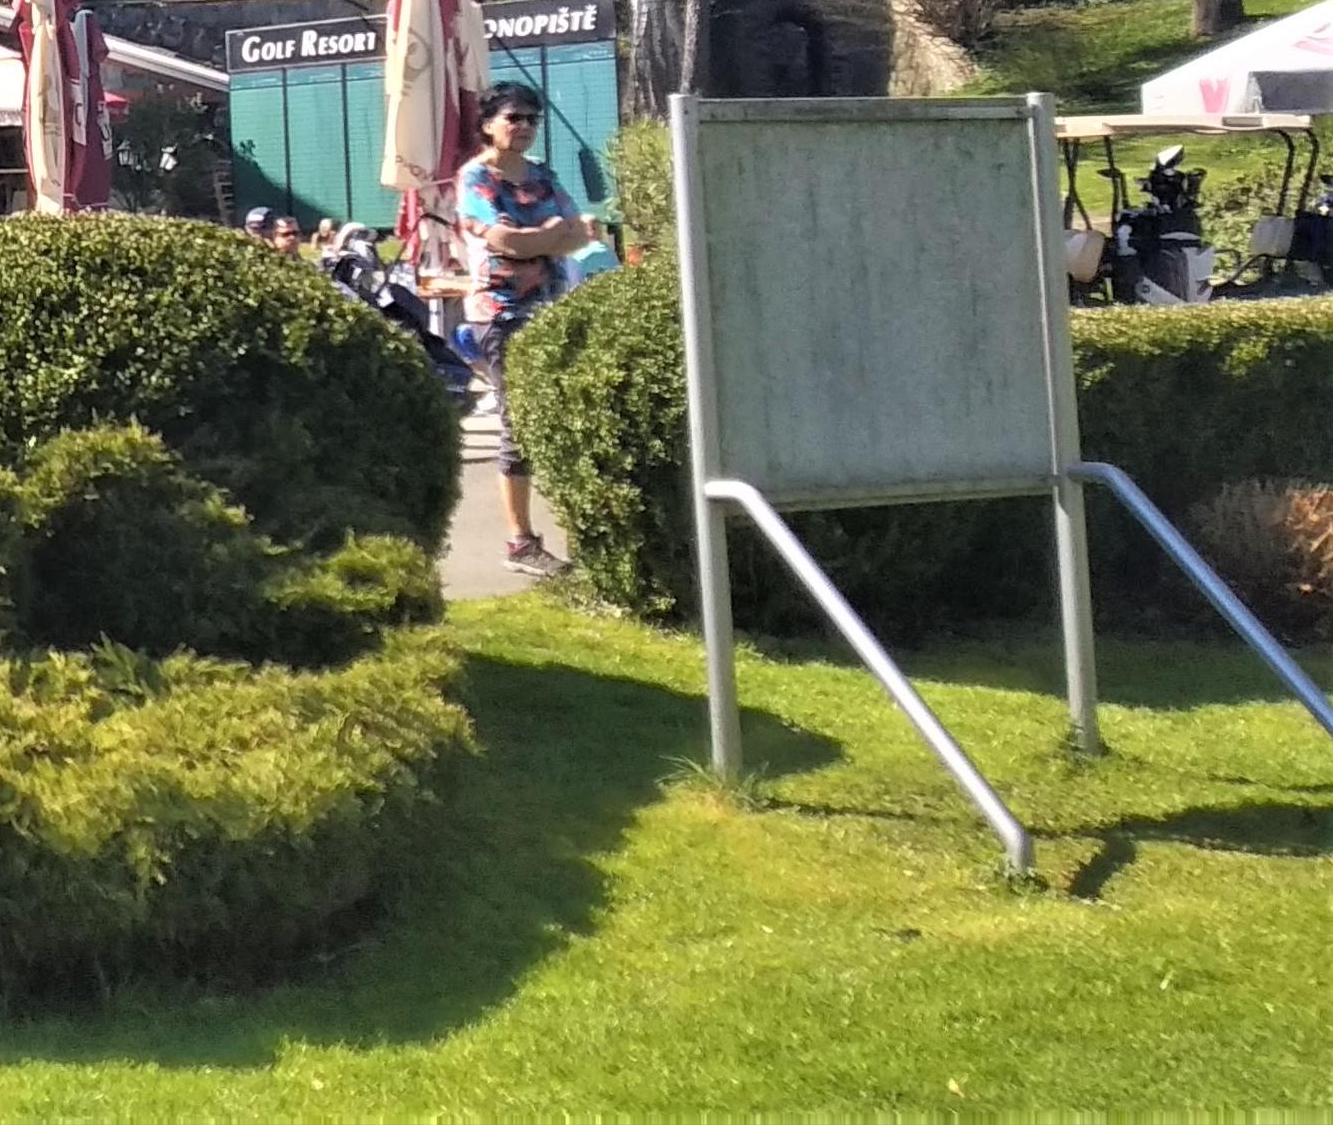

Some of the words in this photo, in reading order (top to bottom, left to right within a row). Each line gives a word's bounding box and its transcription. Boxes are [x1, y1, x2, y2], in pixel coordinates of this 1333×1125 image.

[241, 35, 296, 63] GOLF
[300, 29, 377, 57] RESORT
[483, 3, 597, 39] ONOPIŠTĚ
